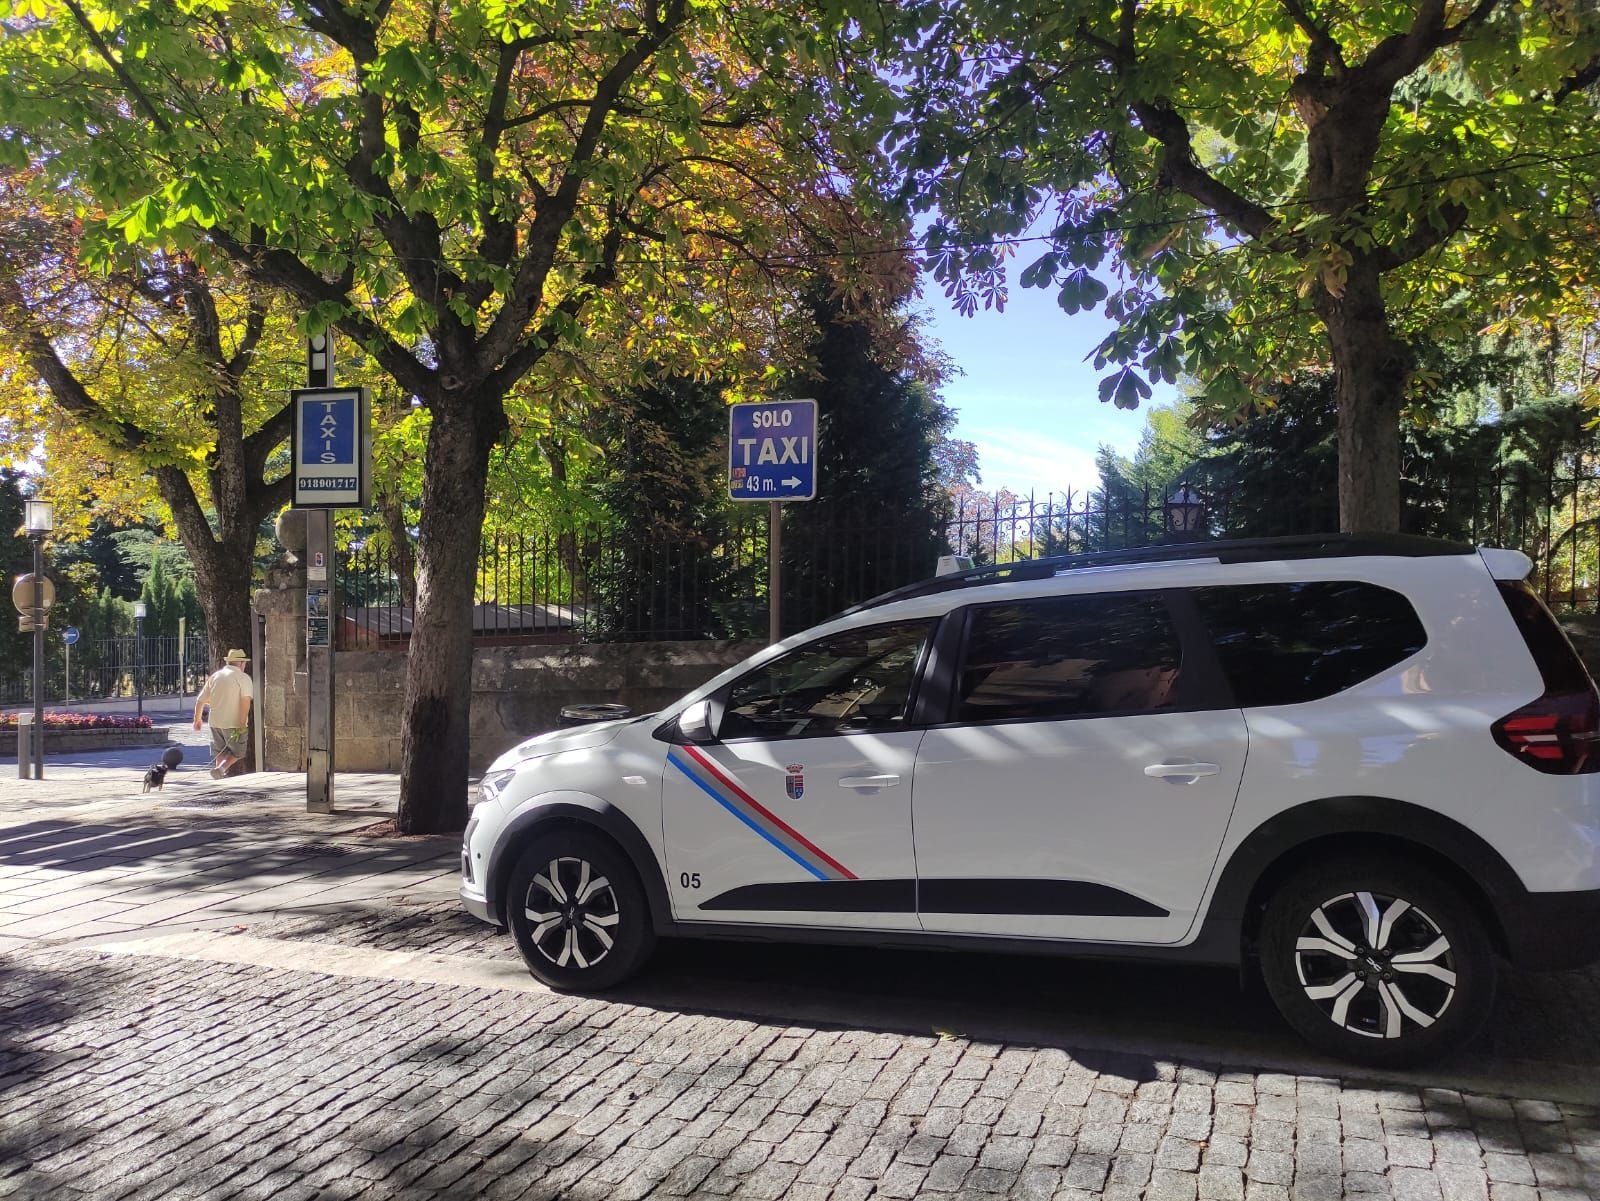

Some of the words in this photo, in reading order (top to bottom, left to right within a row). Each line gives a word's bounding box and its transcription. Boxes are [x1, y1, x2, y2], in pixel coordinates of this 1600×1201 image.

[752, 409, 792, 428] SOLO
[320, 402, 337, 464] TAXIS
[737, 436, 808, 466] TAXI
[300, 478, 356, 488] 918901717
[746, 475, 759, 491] 43
[762, 478, 777, 491] m.
[680, 872, 701, 889] 05
